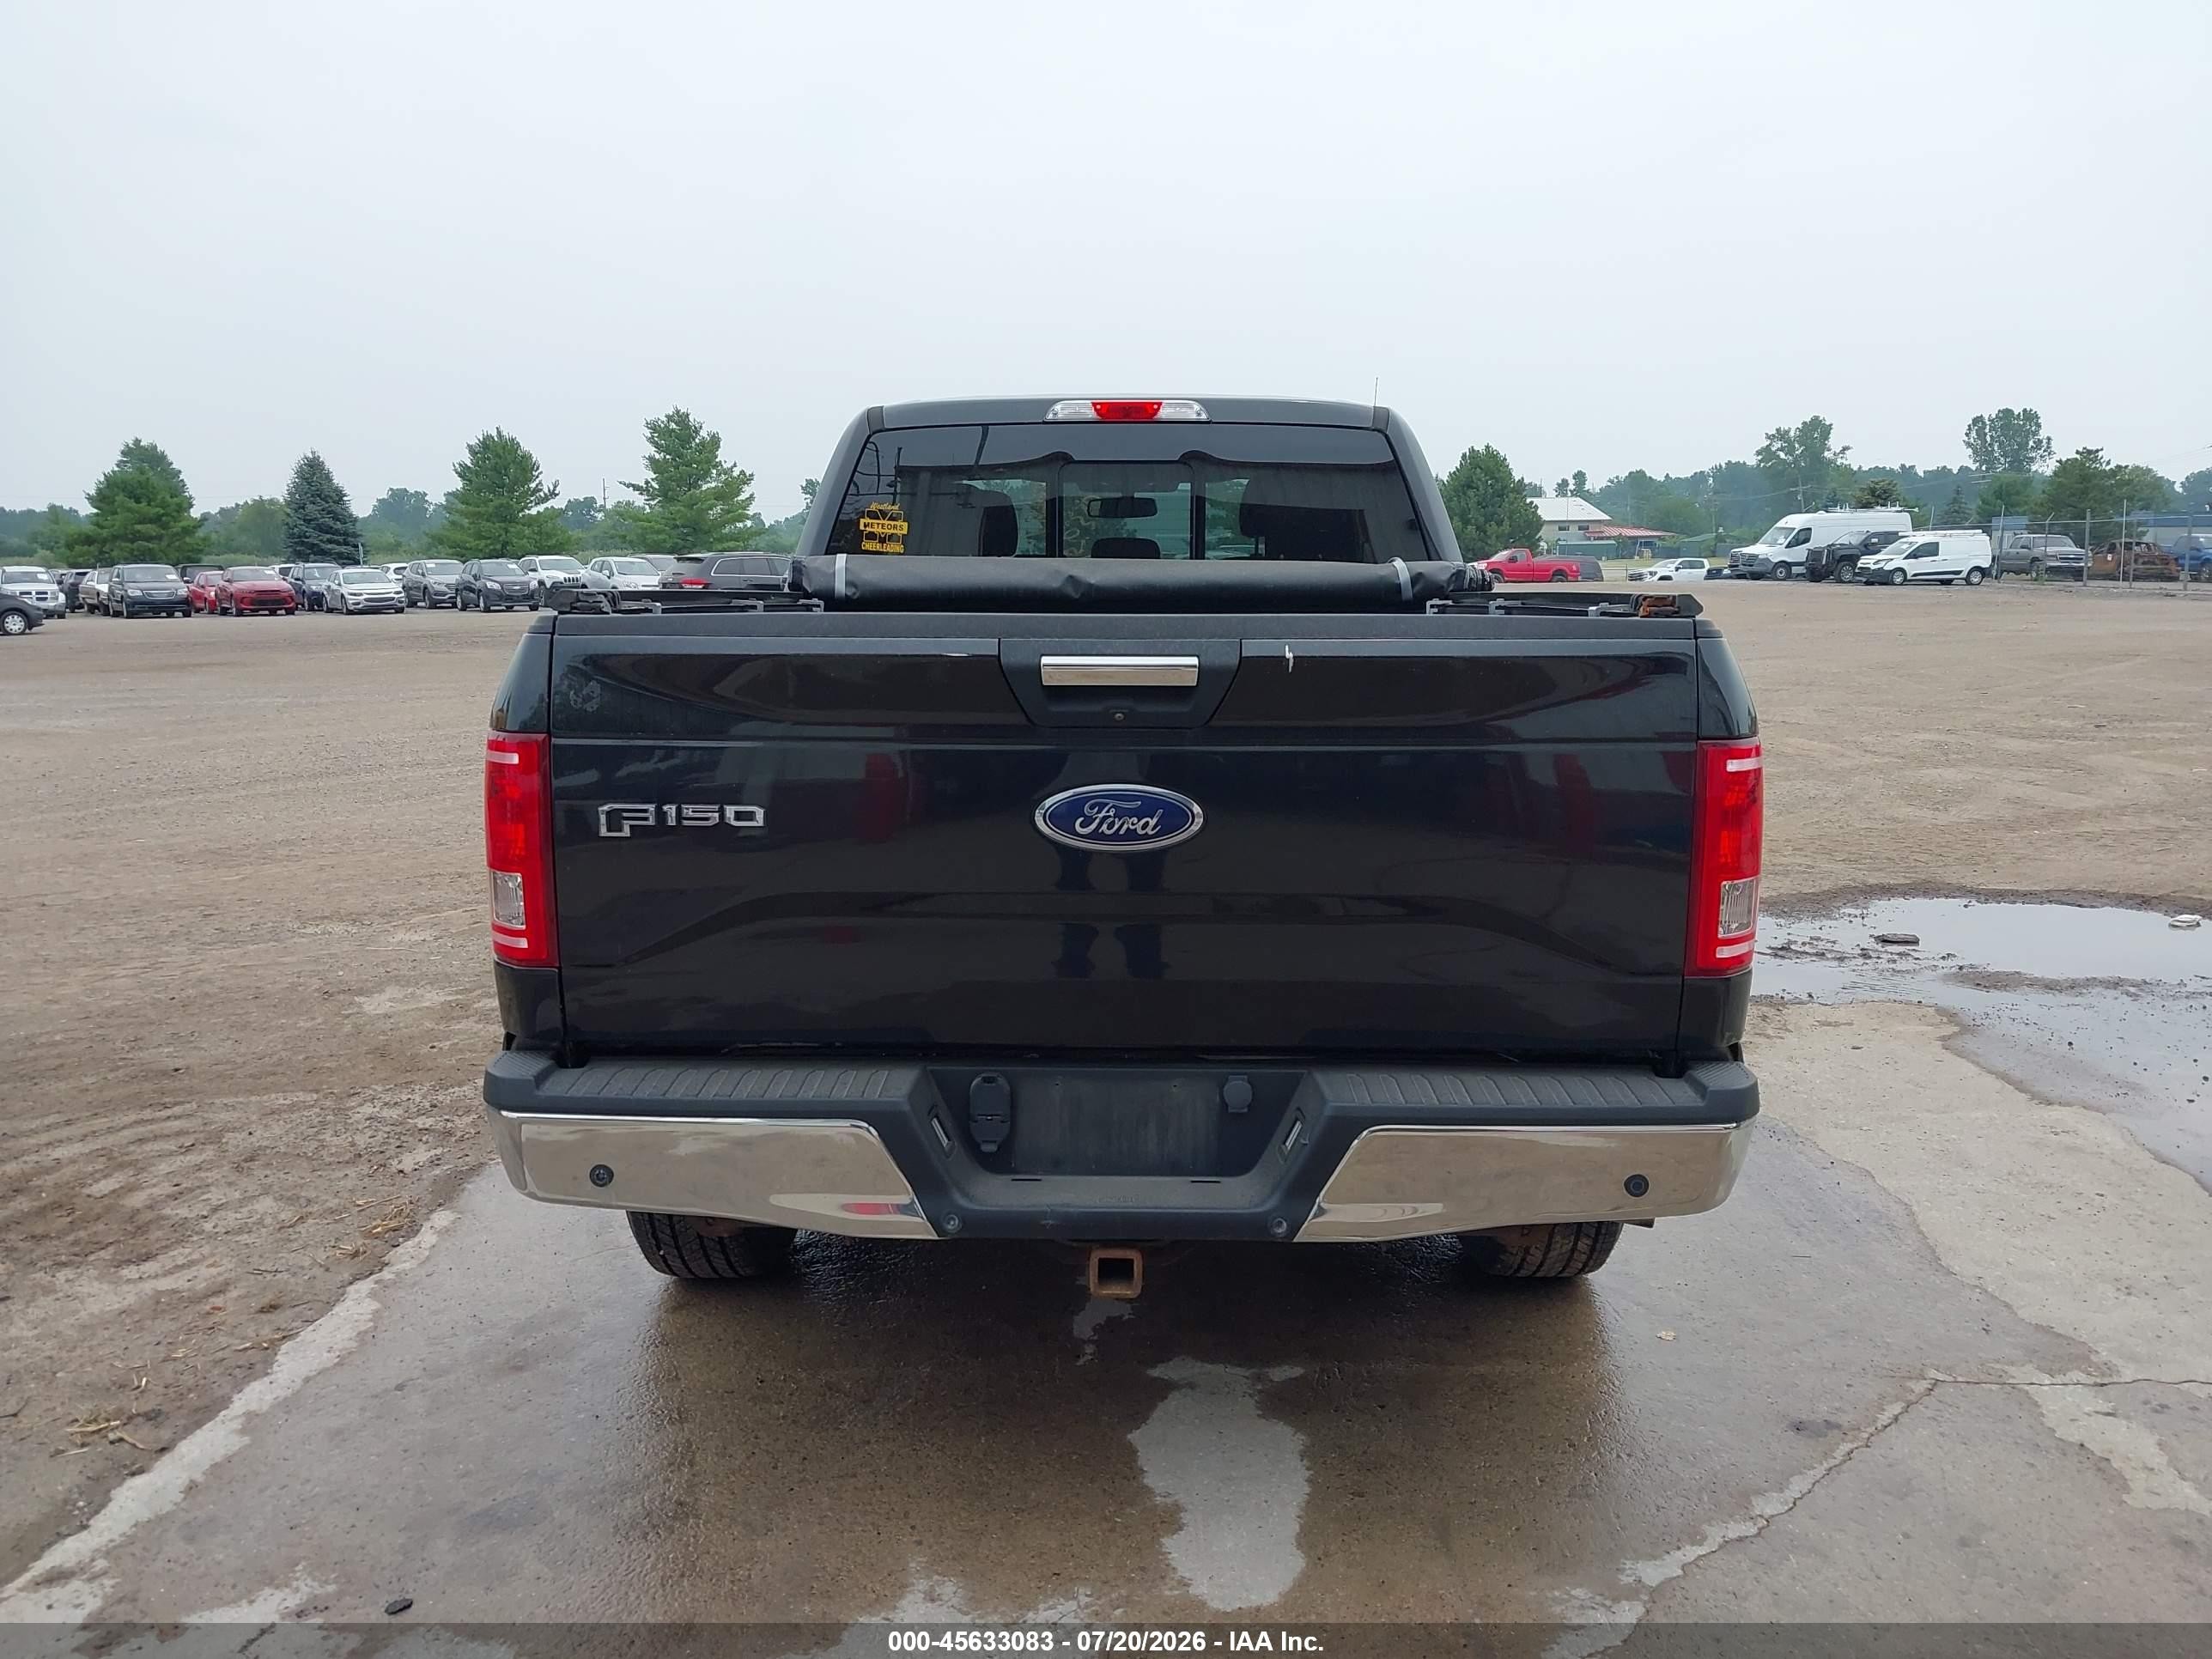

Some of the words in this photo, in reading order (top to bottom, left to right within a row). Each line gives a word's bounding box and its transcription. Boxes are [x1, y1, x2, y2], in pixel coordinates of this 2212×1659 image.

[870, 501, 900, 510] Westland
[864, 521, 904, 532] METEORS
[861, 542, 904, 553] CHEERLEADING
[1074, 799, 1164, 836] Ford
